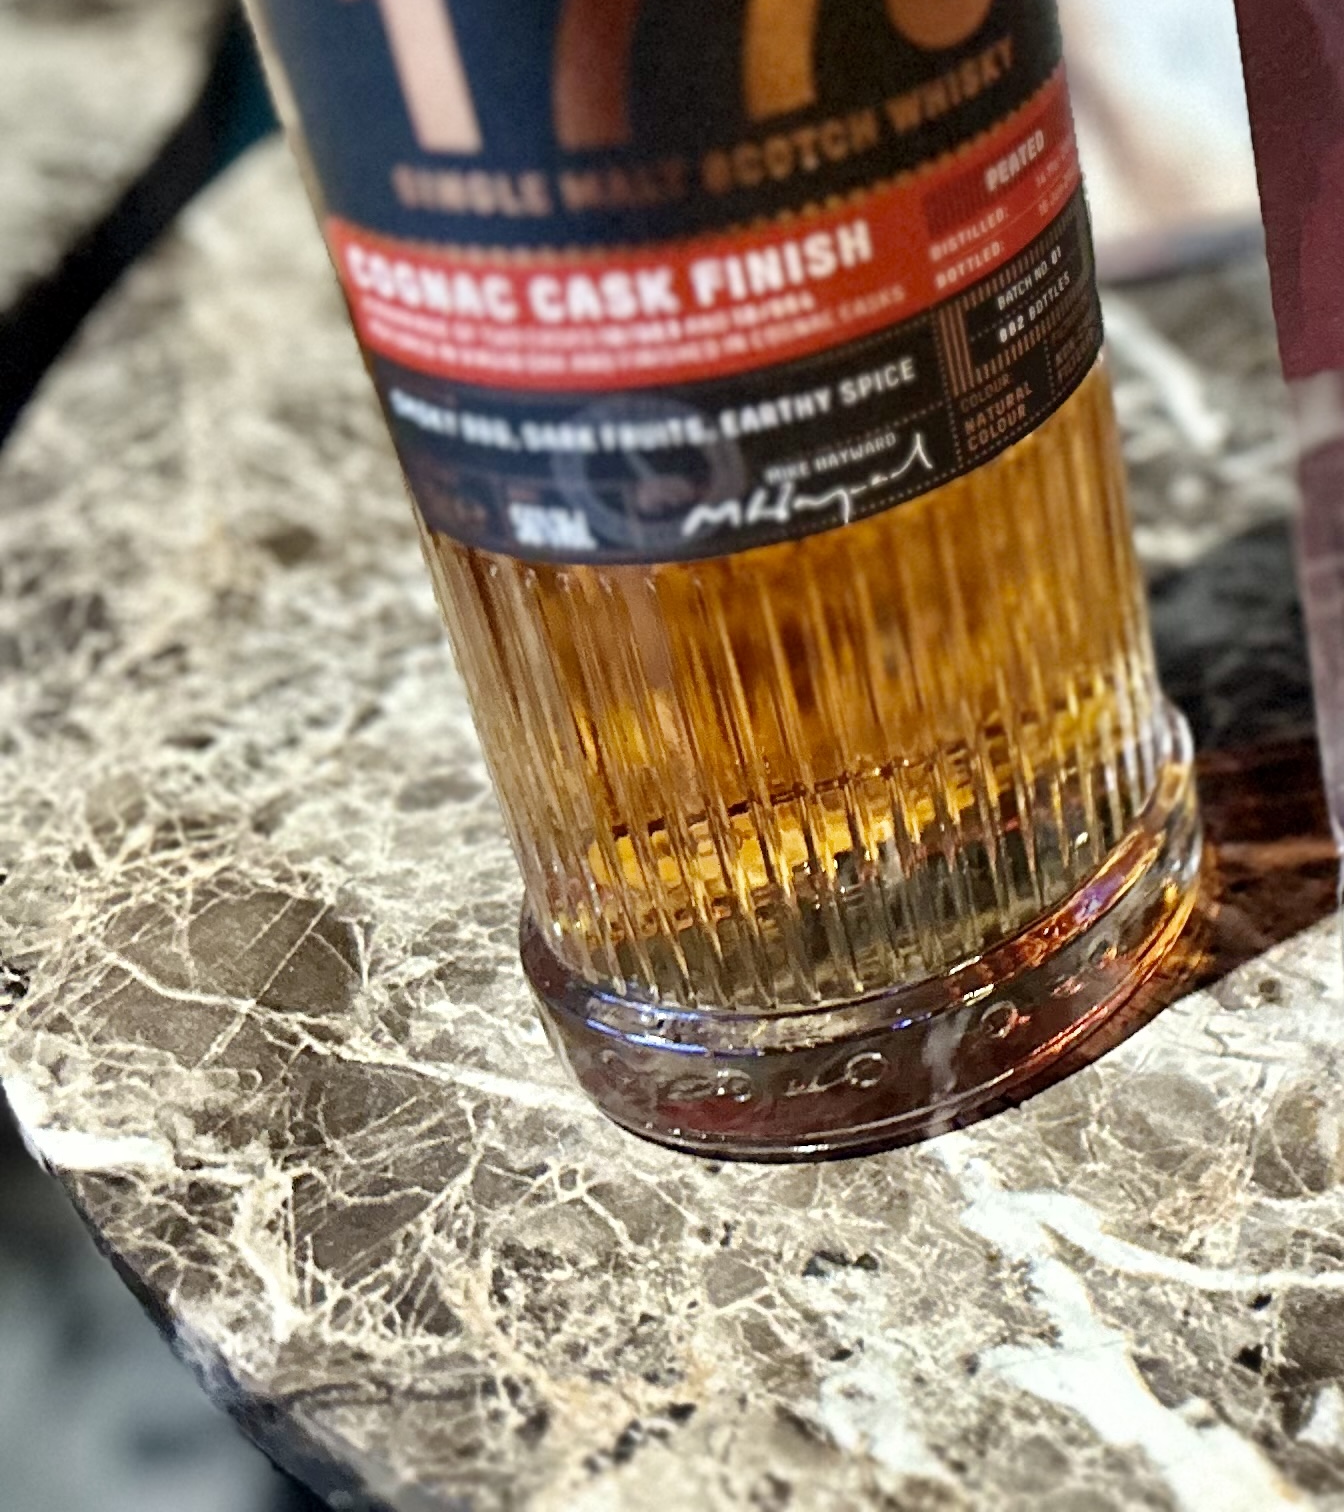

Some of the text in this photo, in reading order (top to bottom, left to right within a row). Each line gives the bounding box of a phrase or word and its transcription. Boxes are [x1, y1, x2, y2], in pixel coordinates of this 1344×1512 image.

[700, 108, 880, 192] SCOTCH
[885, 36, 1017, 133] WHISKY
[984, 129, 1044, 192] PEATED
[345, 242, 519, 324] COGNAC
[527, 267, 681, 325] CASK
[690, 218, 874, 307] FINISH
[997, 275, 1034, 310] BATCH
[1028, 270, 1071, 322] BOTTLES
[718, 389, 831, 440] EARTHY
[840, 356, 916, 406] SPICE
[964, 382, 1033, 435] NATURAL
[814, 431, 897, 473] HAYWARD
[967, 403, 1027, 452] COLOUR
